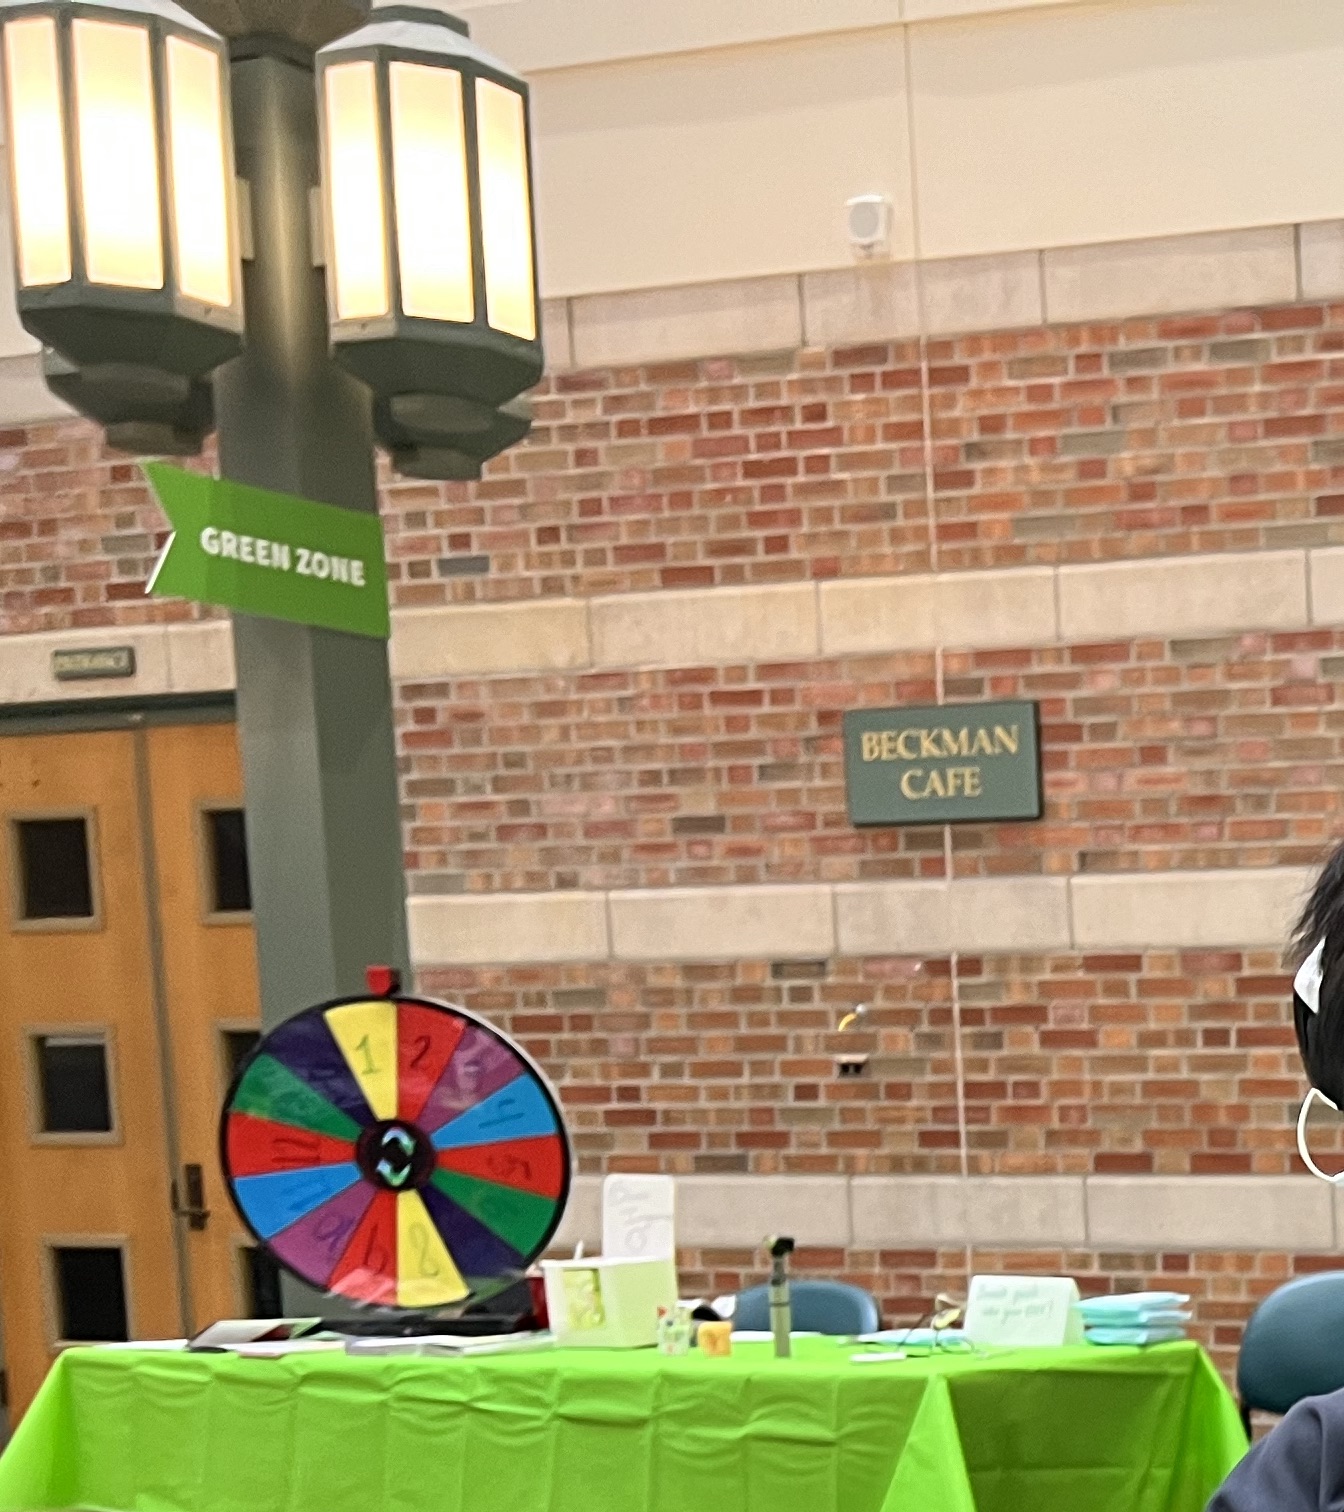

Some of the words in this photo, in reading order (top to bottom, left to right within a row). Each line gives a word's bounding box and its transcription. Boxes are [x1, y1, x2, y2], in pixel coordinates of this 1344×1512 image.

[200, 526, 291, 571] GREEN
[295, 548, 366, 587] ZONE
[862, 725, 1018, 762] BECKMAN
[901, 766, 983, 800] CAFE
